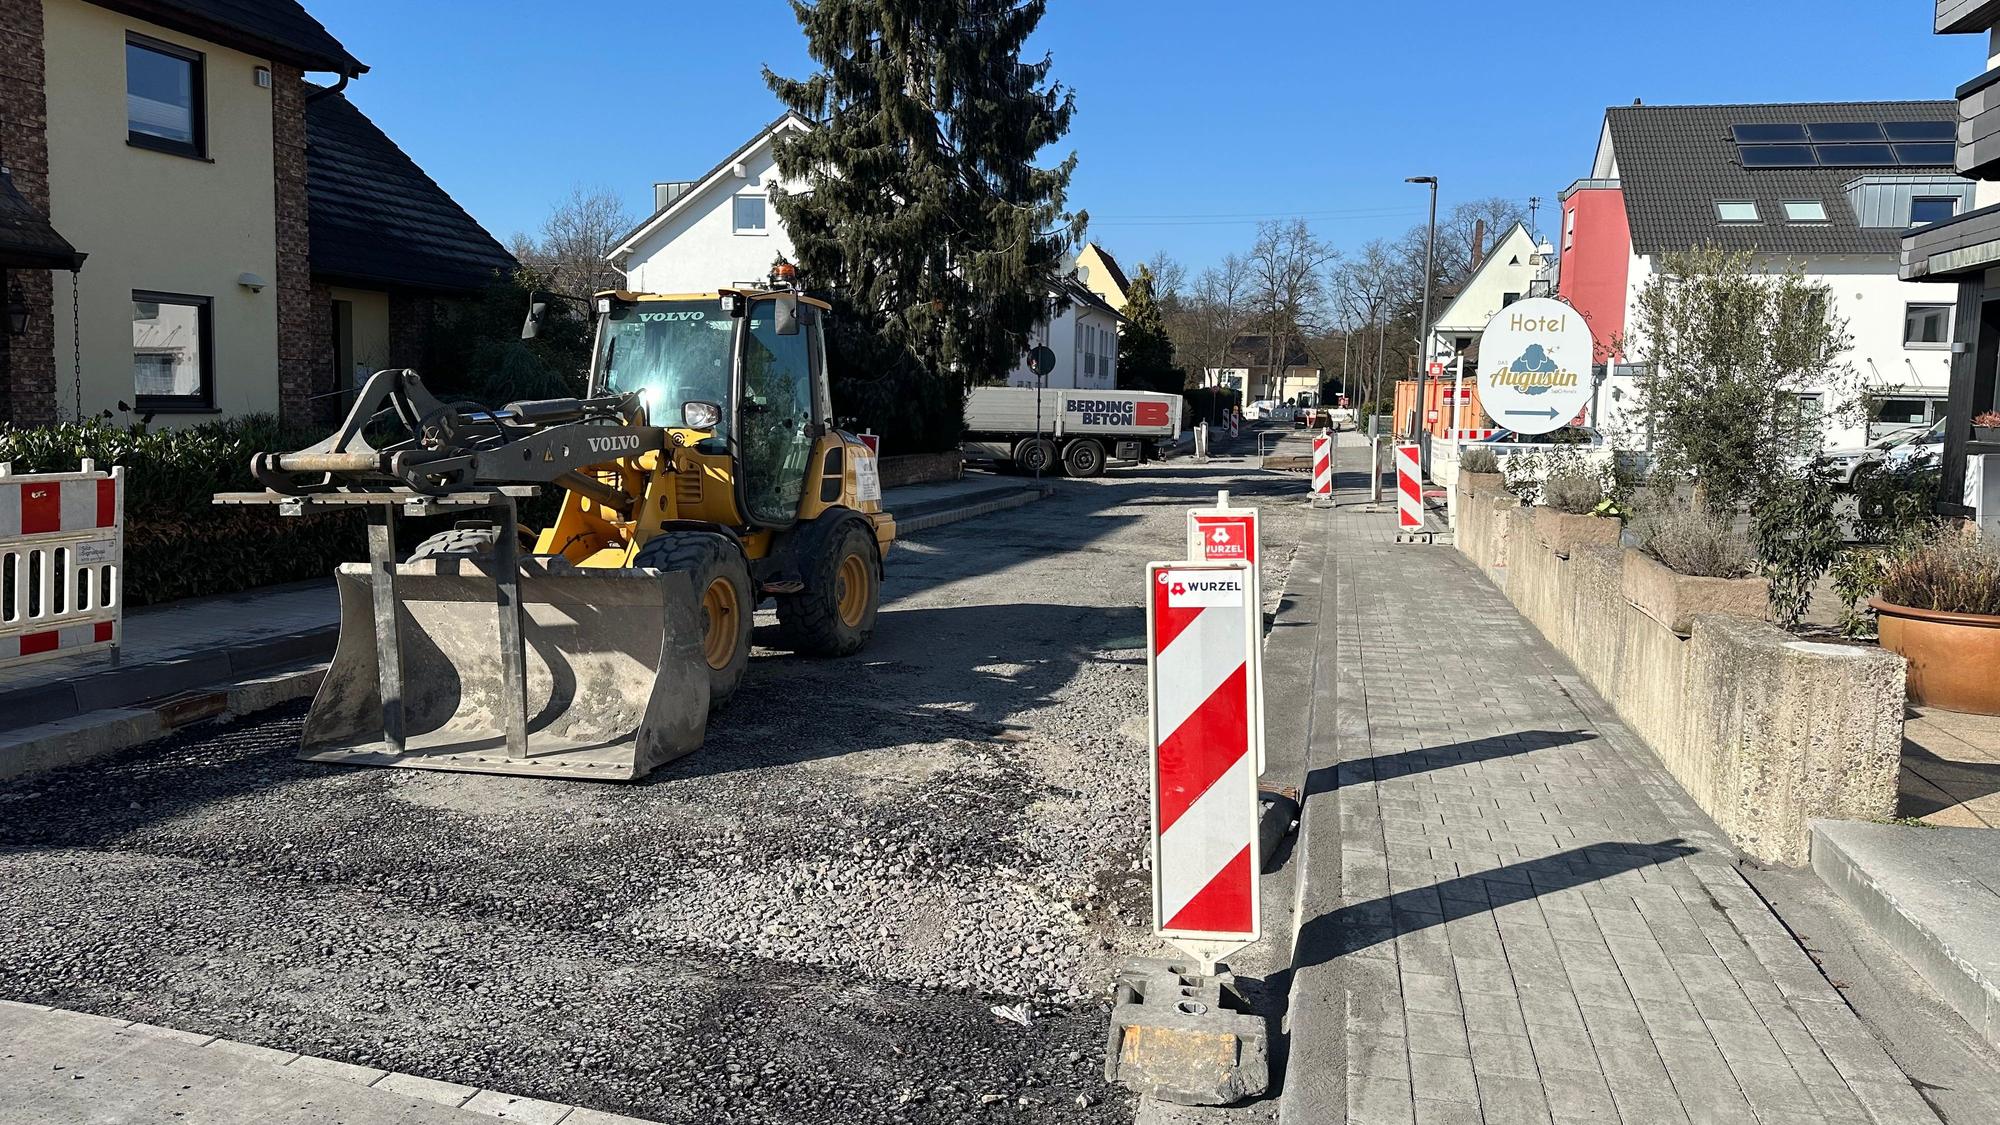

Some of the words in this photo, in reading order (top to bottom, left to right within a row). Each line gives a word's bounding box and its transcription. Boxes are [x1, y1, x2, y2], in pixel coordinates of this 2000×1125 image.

[638, 311, 705, 322] VOLVO
[1510, 313, 1566, 332] Hotel
[1489, 367, 1578, 391] Augustin
[1066, 400, 1133, 413] BERDING
[1082, 413, 1132, 426] BETON
[587, 435, 640, 453] VOLVO
[1188, 582, 1242, 591] WURZEL
